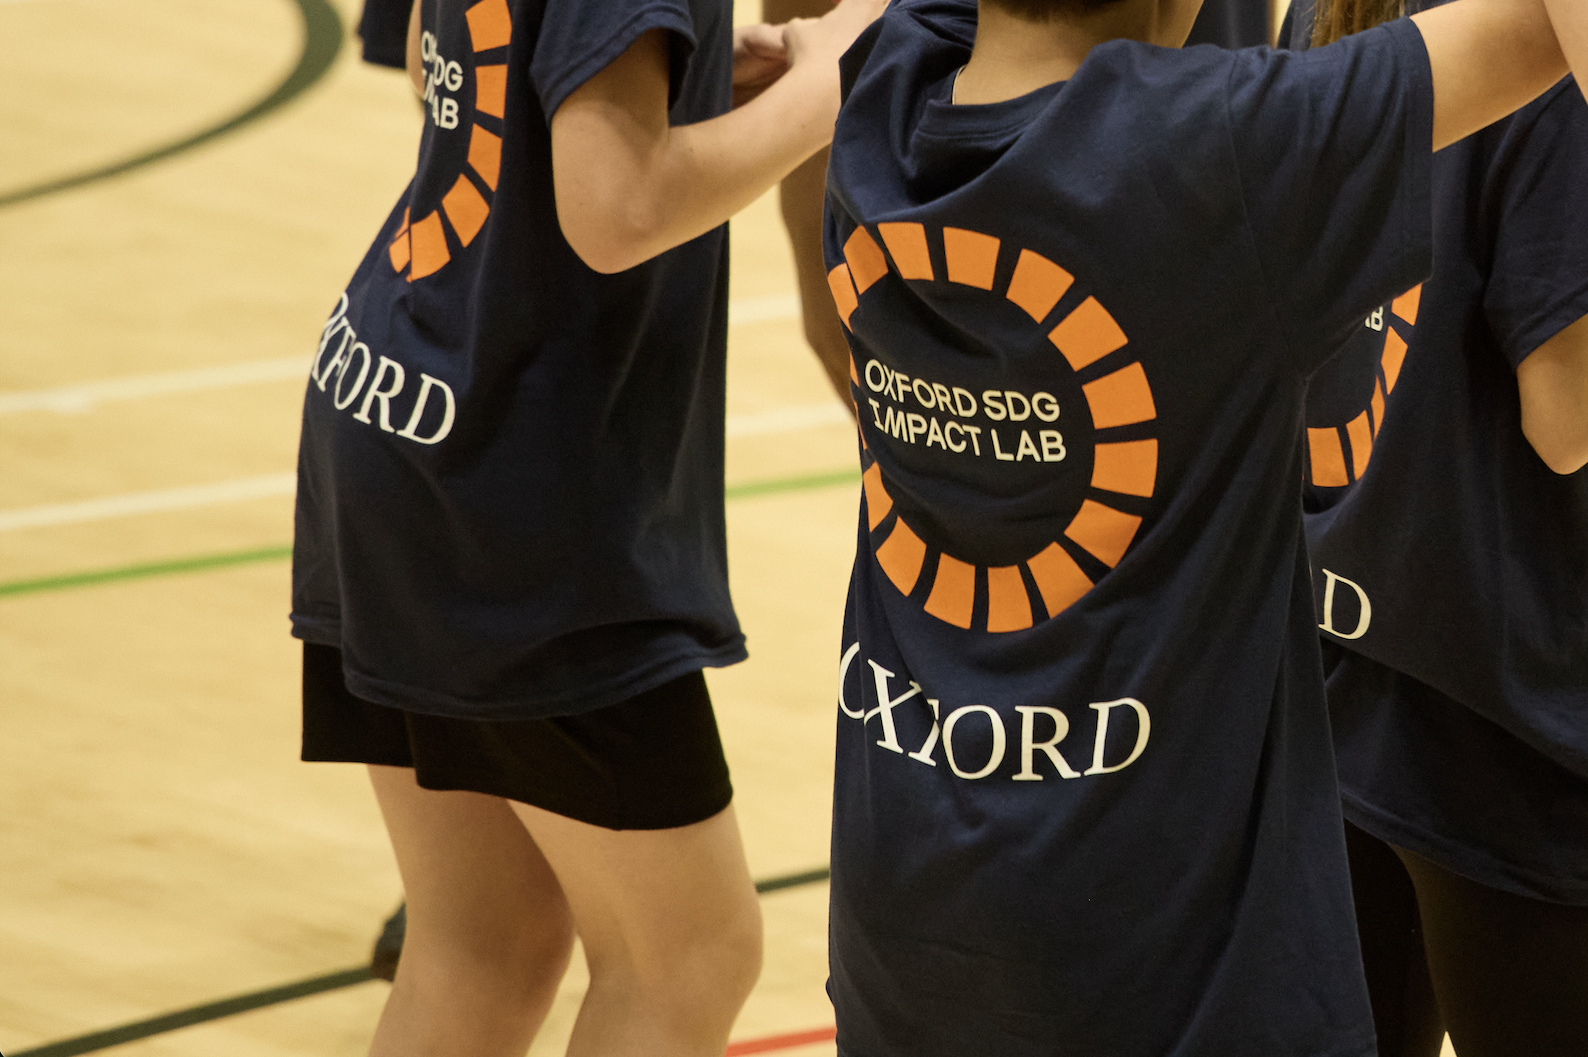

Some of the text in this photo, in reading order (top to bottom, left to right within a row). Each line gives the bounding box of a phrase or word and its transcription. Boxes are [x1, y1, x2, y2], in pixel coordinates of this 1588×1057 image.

[865, 359, 1061, 423] OXFORD SDG
[868, 398, 1067, 462] IMPACT LAB
